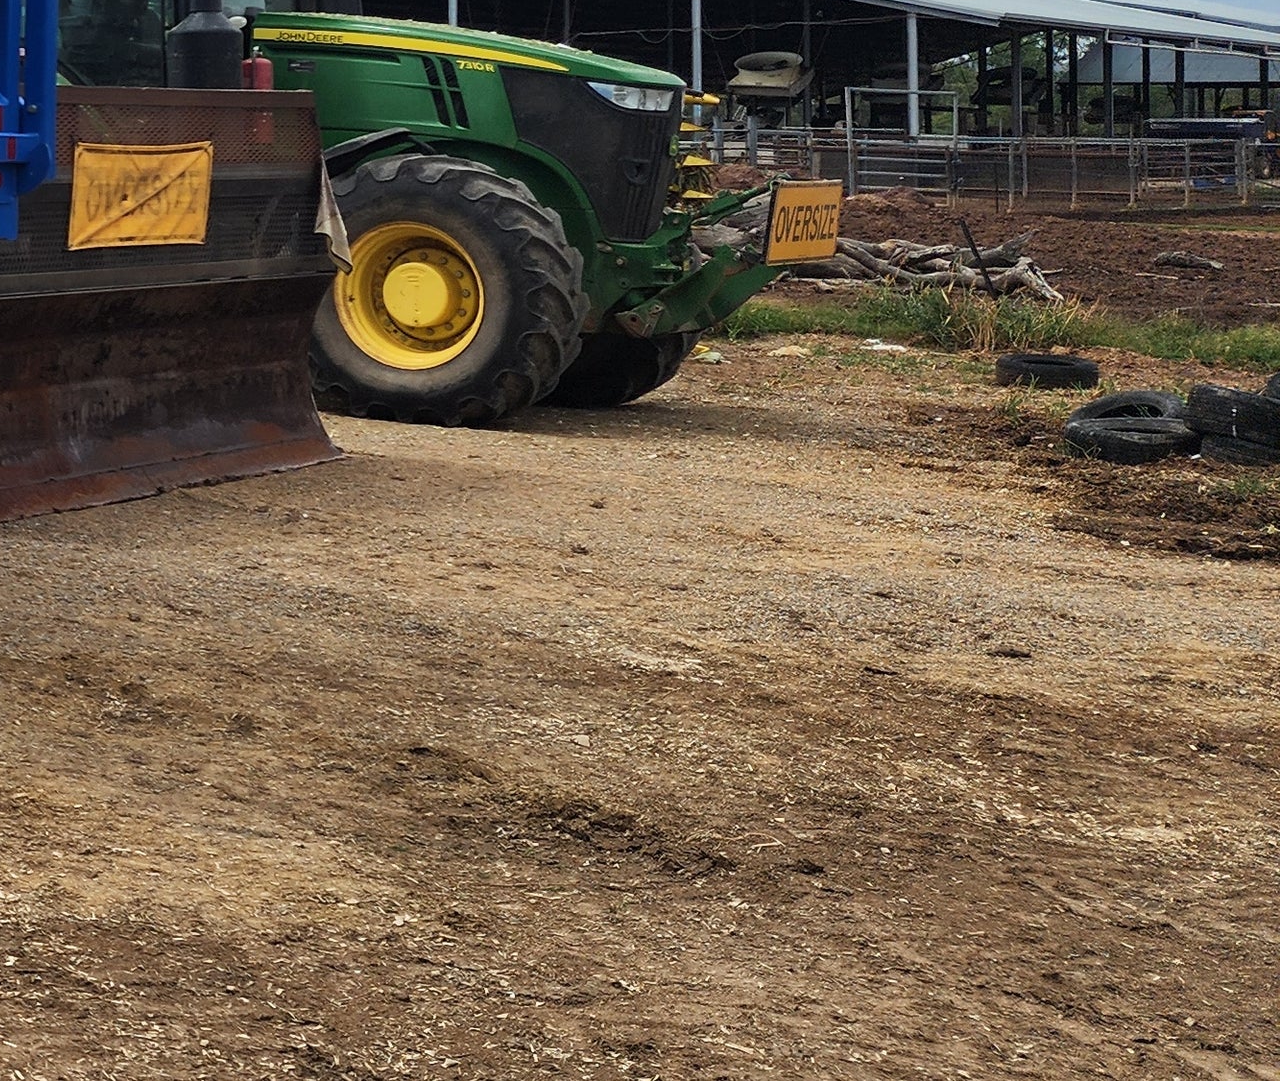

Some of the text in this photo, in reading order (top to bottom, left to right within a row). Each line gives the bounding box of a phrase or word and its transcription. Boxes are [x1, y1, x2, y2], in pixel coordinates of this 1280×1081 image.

[276, 30, 344, 43] JOHN DEERE
[775, 204, 837, 243] OVERSIZE
